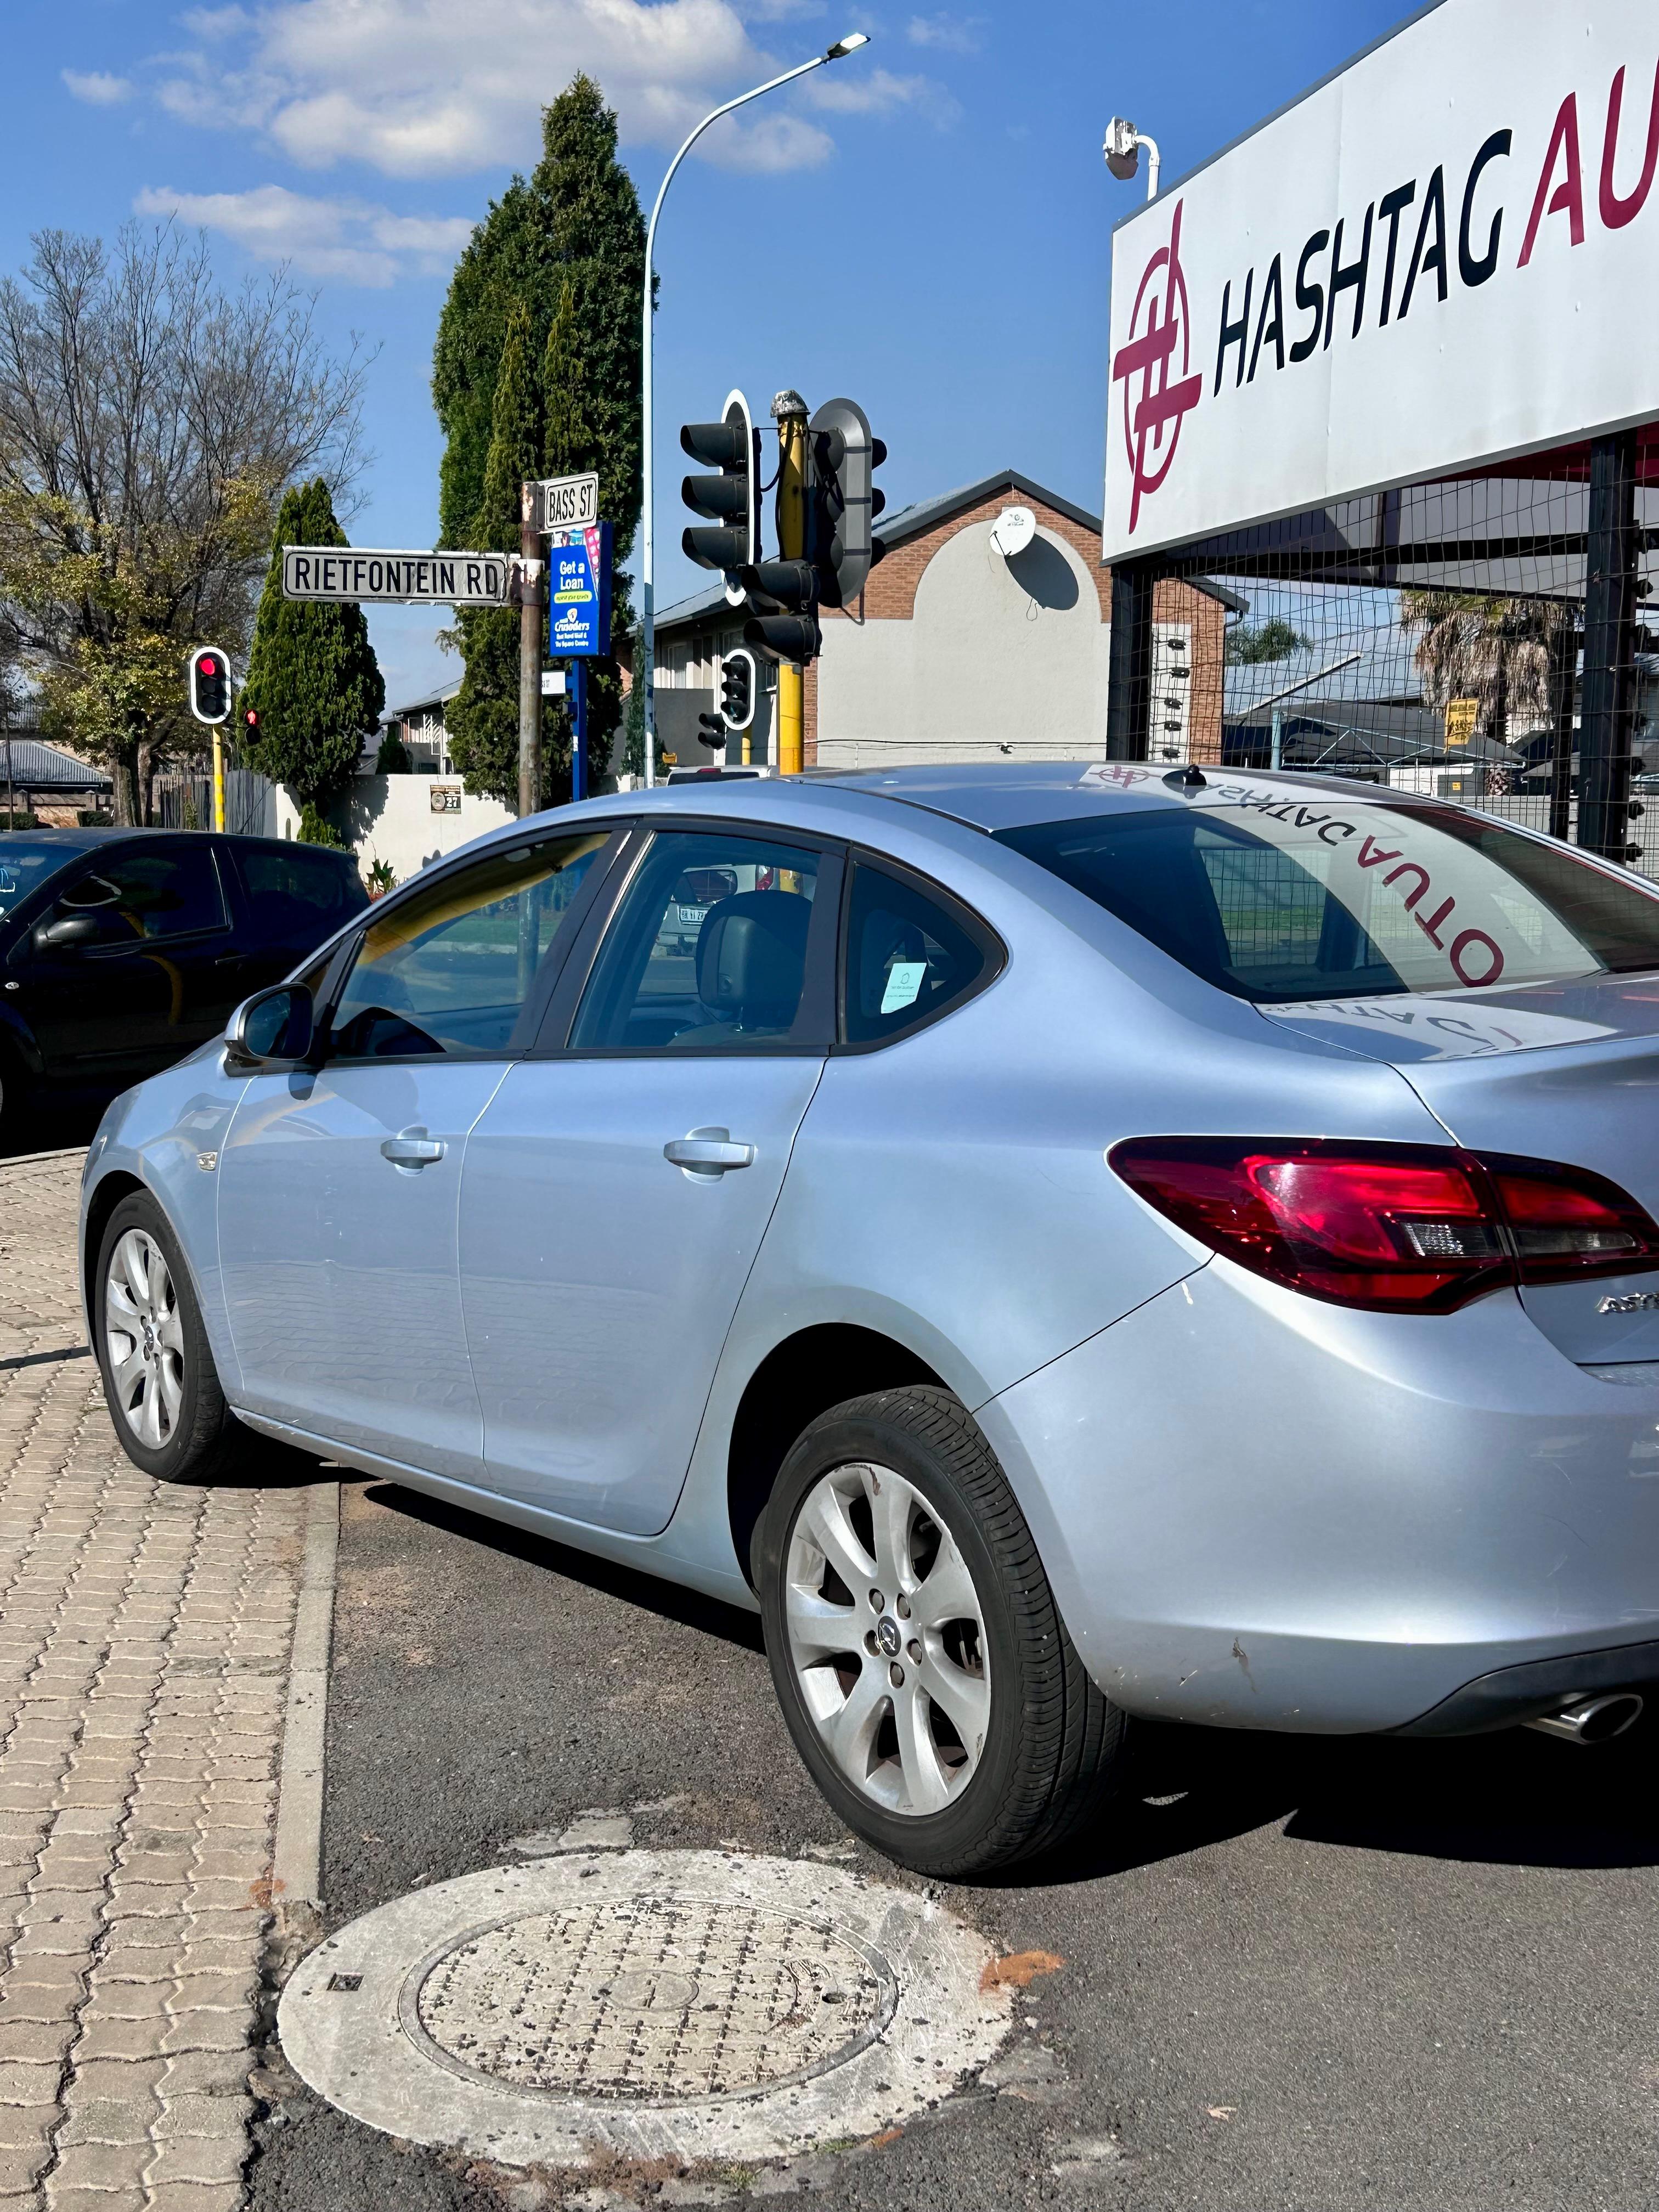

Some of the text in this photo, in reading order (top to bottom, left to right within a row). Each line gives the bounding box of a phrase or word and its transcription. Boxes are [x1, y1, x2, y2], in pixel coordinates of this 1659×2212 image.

[1214, 128, 1513, 397] HASHTAG
[549, 483, 593, 522] BASS ST
[295, 557, 499, 596] RIETFONTEIN RD
[560, 561, 585, 575] Get a
[560, 576, 584, 591] Loan
[446, 797, 458, 808] 27
